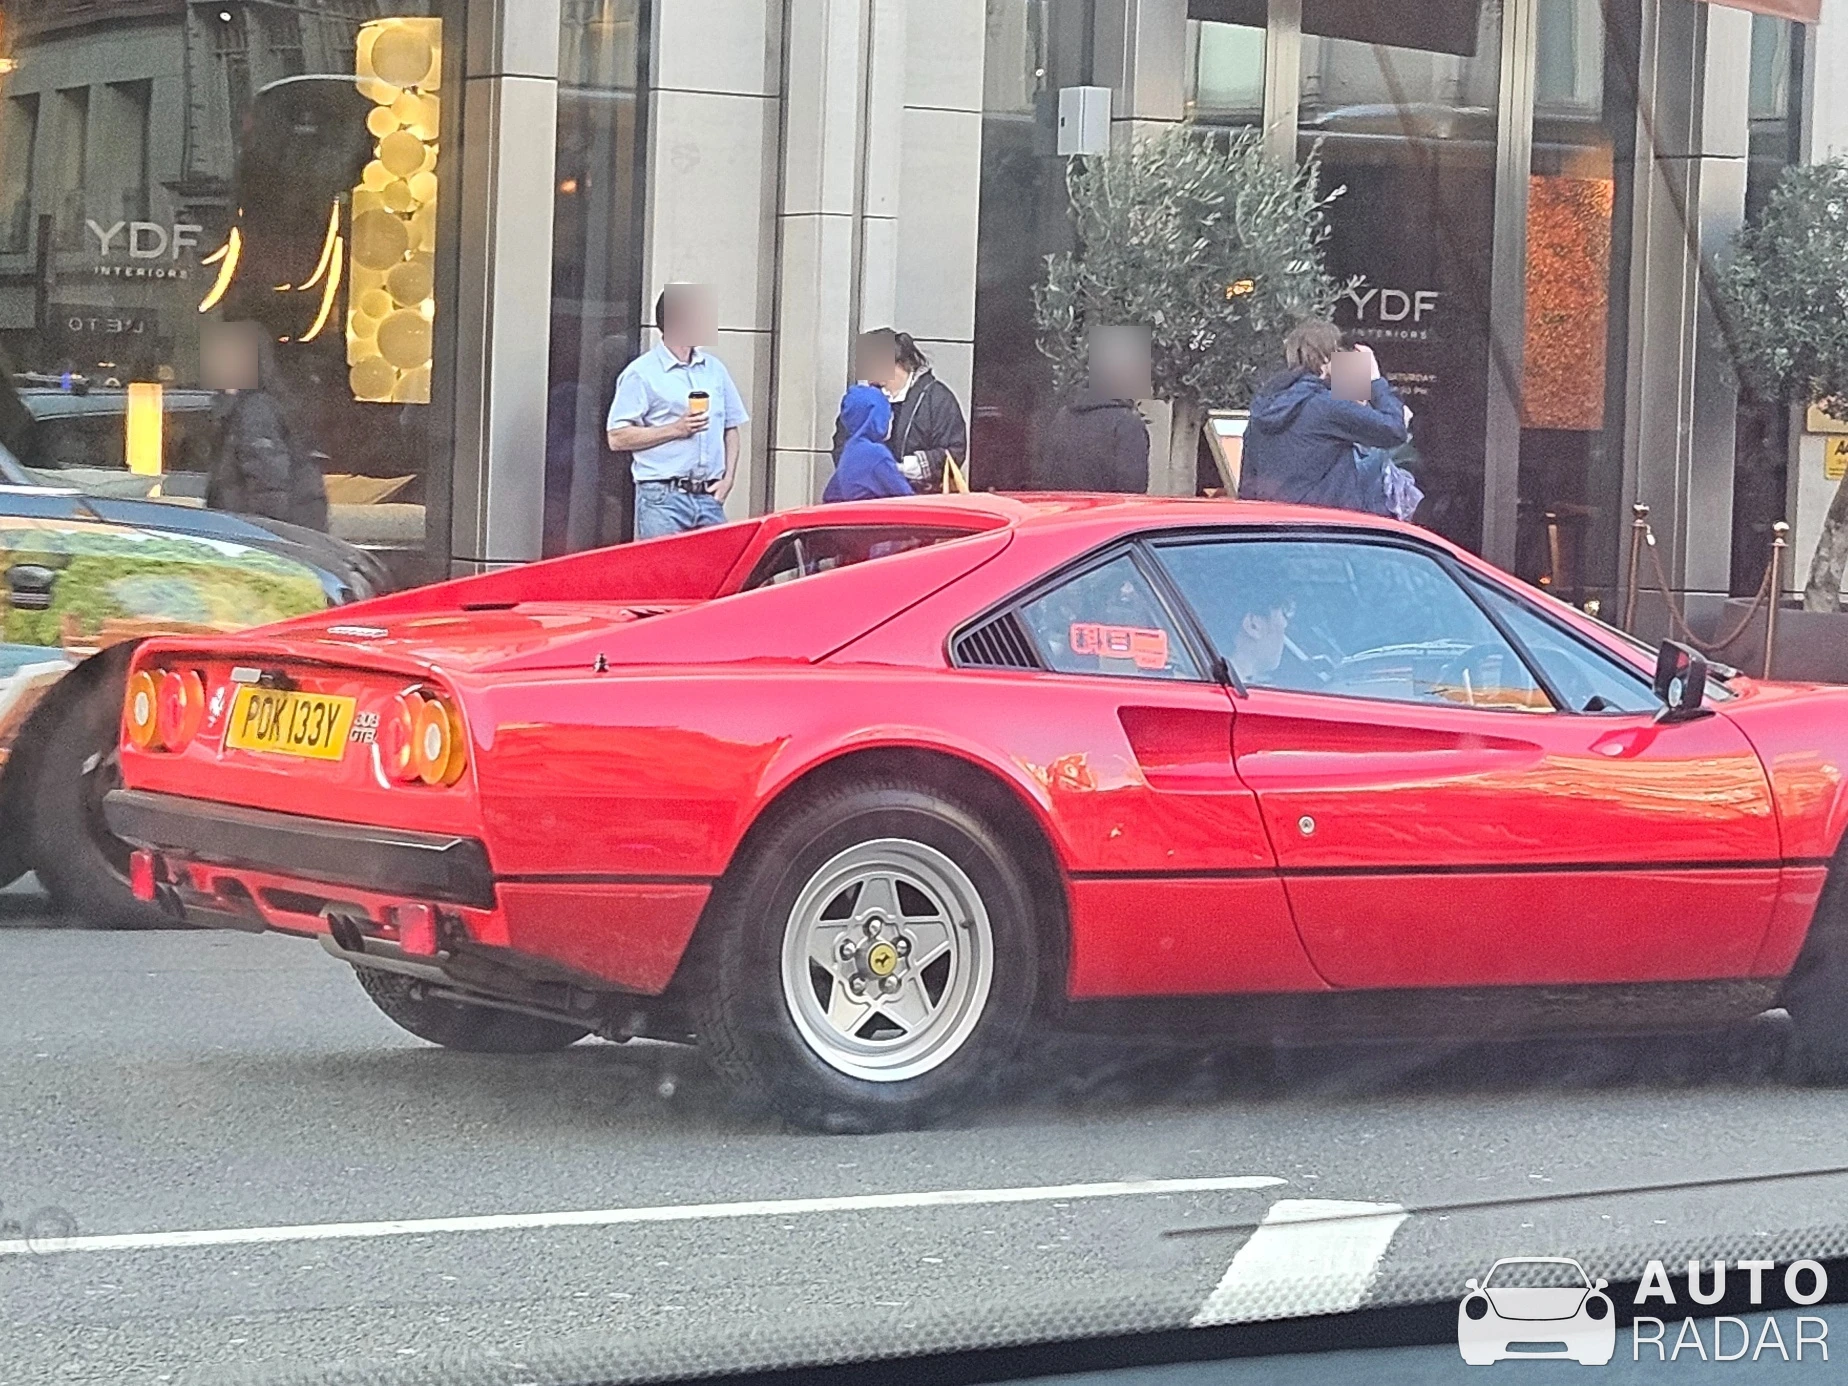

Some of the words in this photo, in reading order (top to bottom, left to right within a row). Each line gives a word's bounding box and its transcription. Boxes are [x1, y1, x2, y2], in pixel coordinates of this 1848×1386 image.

[86, 219, 203, 260] YDF
[94, 265, 188, 280] INTERIORS
[1349, 288, 1439, 322] YDF
[1351, 328, 1428, 340] INTERIORS
[286, 699, 341, 748] 133Y
